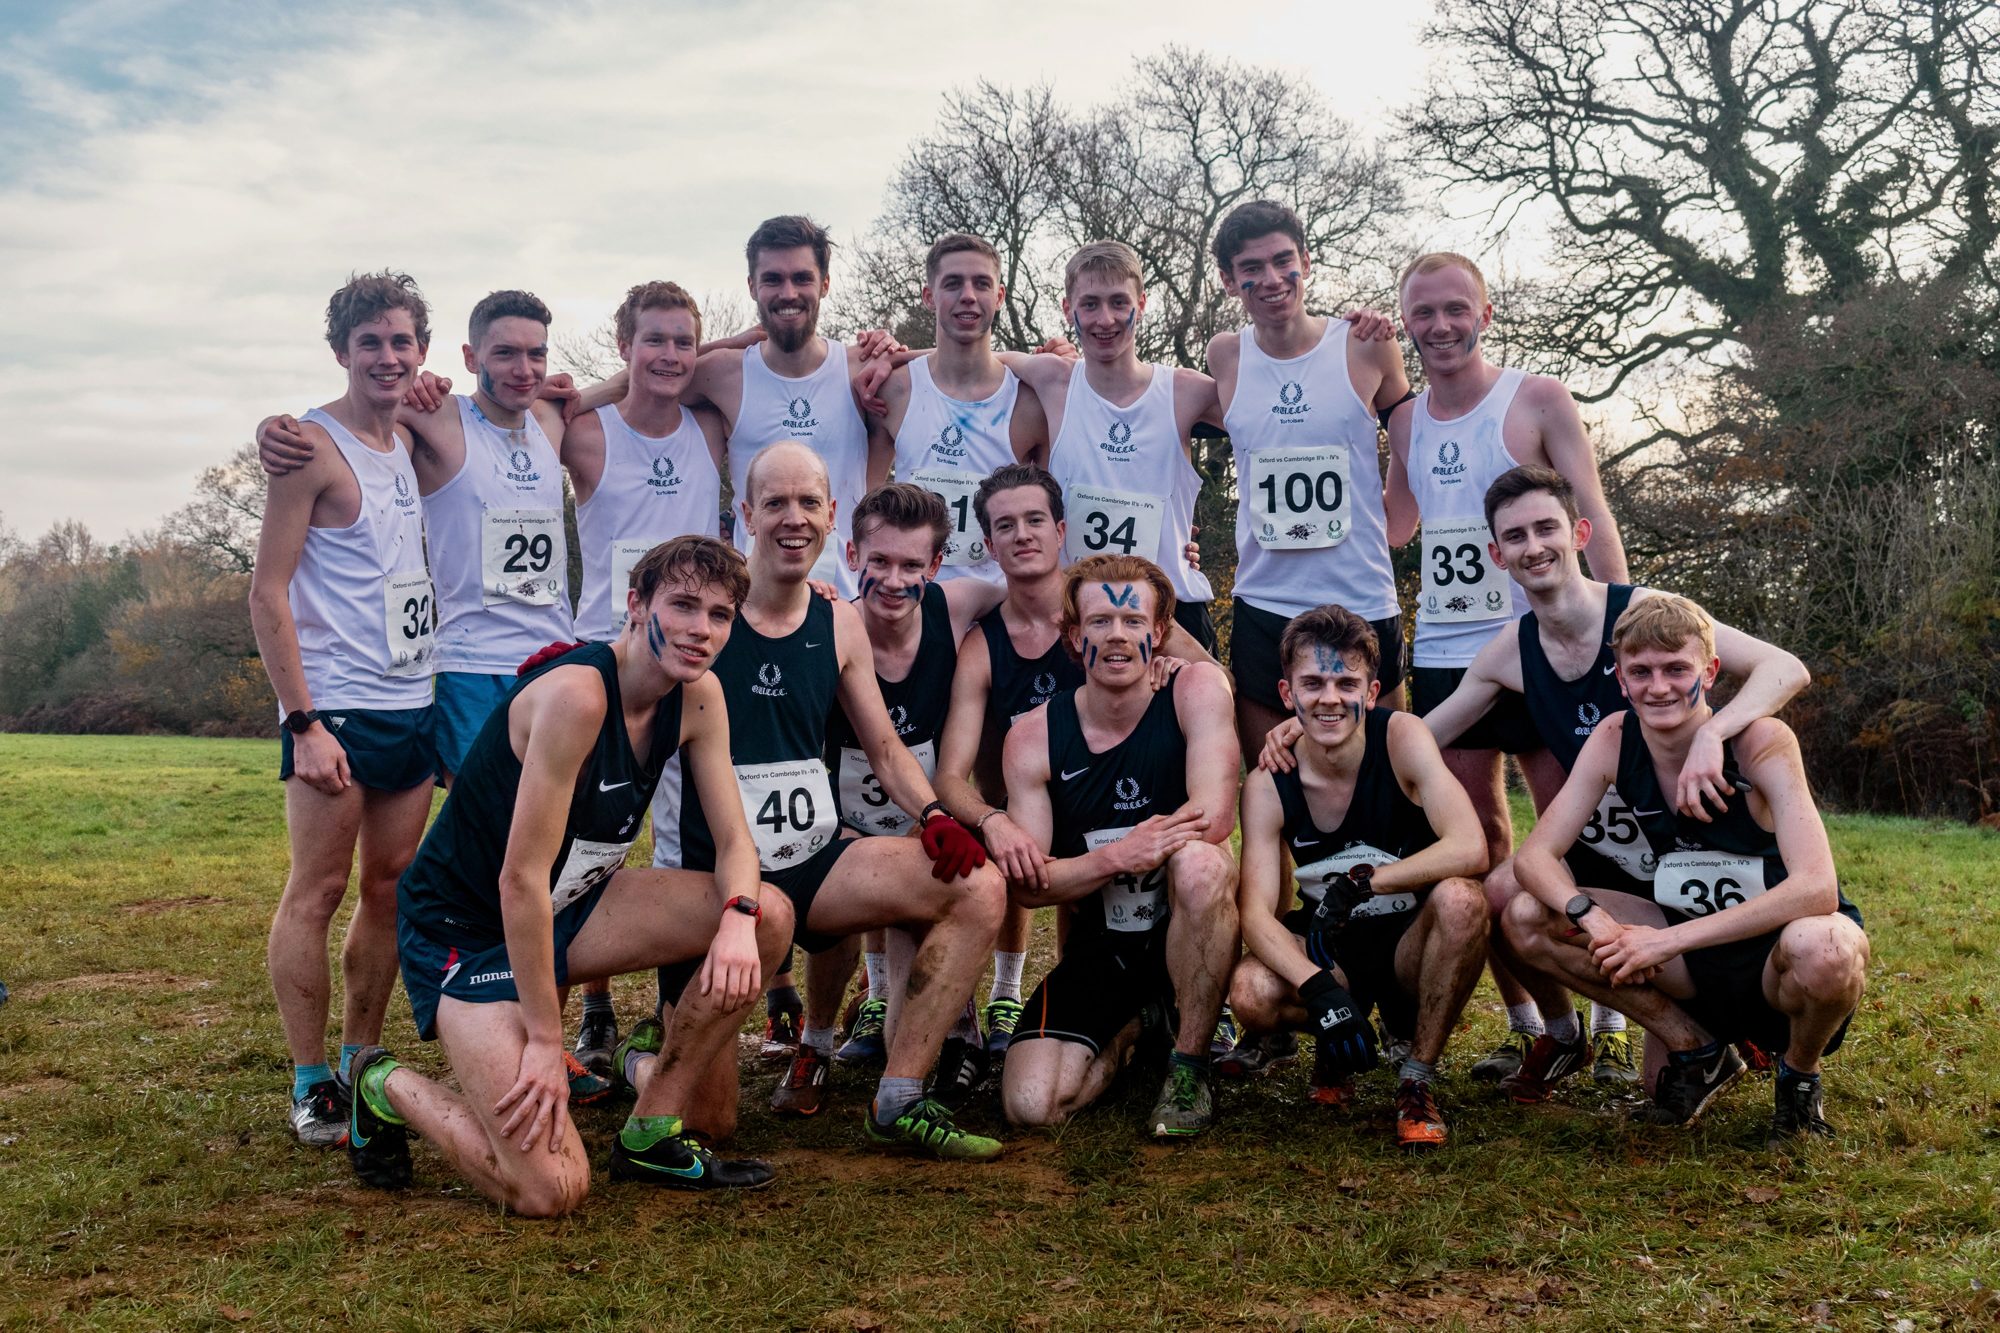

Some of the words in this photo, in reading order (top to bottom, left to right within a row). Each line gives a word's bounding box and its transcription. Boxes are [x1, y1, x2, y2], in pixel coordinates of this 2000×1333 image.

[936, 457, 958, 466] Tortoises
[1284, 455, 1315, 463] Cambridge
[937, 477, 965, 485] Cambridge
[1259, 471, 1343, 513] 100
[1077, 493, 1094, 501] Oxford
[1101, 496, 1130, 506] Cambridge
[1083, 511, 1137, 555] 34
[503, 534, 553, 573] 29
[1432, 543, 1485, 587] 33
[392, 582, 408, 590] Oxford
[403, 594, 430, 640] 32
[770, 770, 801, 778] Cambridge
[862, 774, 889, 807] 3
[756, 787, 815, 834] 40
[581, 849, 602, 857] Oxford
[1334, 853, 1366, 861] Cambridge
[1691, 860, 1721, 868] Cambridge
[1681, 878, 1746, 917] 36
